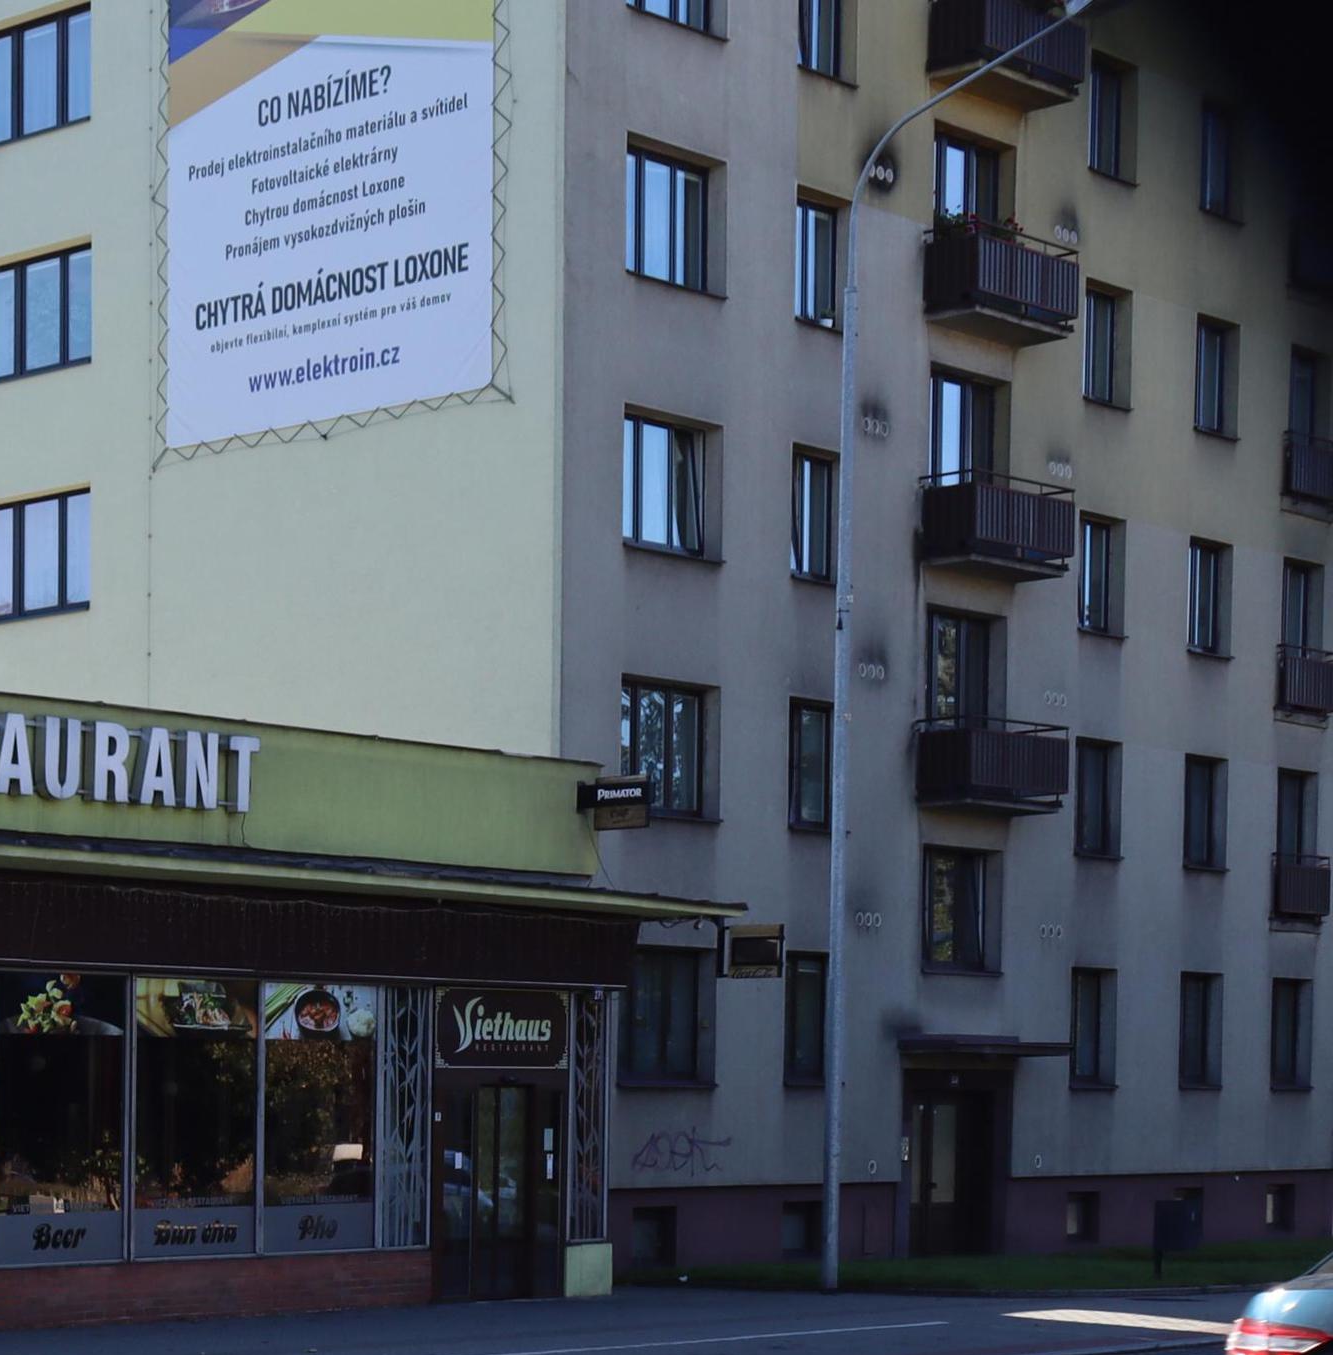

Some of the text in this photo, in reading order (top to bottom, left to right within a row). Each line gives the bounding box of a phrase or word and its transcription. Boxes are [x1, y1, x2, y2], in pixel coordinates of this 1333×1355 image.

[258, 64, 392, 127] CO NABÍZÍME?
[188, 92, 469, 181] Prodej elektroinstalačního materiálu a svítidel
[251, 146, 399, 195] Fotovoltaické elektrárny
[244, 176, 406, 227] Chytrou domácnost Loxone
[225, 198, 426, 261] Pronájem vysokozdvižných plošin
[195, 242, 469, 331] CHYTRÁ DOMÁCNOST LOXONE
[210, 292, 452, 354] objevte flexibilní, komplexní systém pro váš domov
[248, 345, 401, 393] www.elektroin.cz
[596, 787, 643, 801] PRIMATOR
[452, 996, 552, 1054] Viethaus
[32, 1223, 87, 1251] Beer
[297, 1214, 339, 1241] Pho
